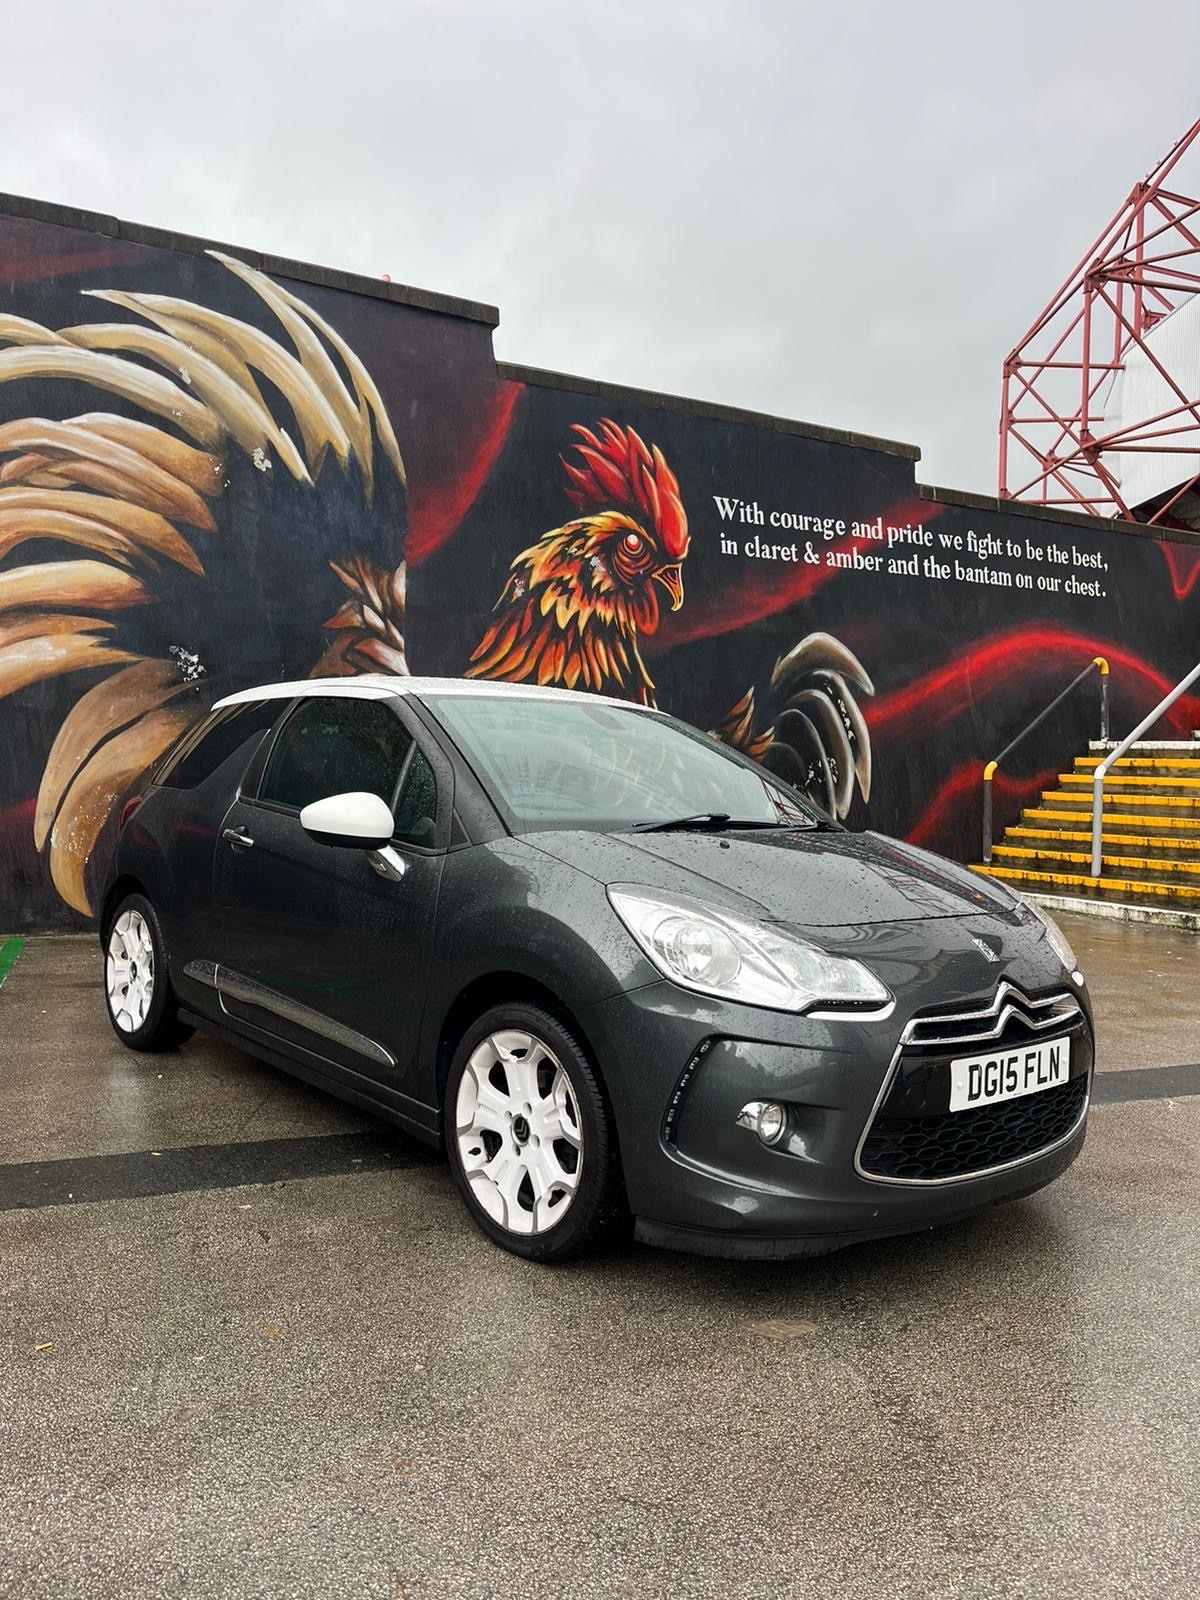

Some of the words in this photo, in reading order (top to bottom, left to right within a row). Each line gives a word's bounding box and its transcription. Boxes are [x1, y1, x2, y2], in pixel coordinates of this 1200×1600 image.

[713, 496, 765, 525] With
[770, 512, 846, 540] courage
[852, 517, 883, 540] and
[887, 524, 934, 548] pride
[938, 533, 963, 550] we
[966, 530, 1004, 560] fight
[1006, 539, 1022, 558] to
[1025, 539, 1044, 561] be
[1046, 544, 1069, 565] the
[1072, 546, 1108, 572] best,
[720, 532, 738, 555] in
[744, 535, 799, 562] claret
[804, 541, 821, 565] &
[826, 546, 884, 572] amber
[888, 554, 920, 576] and
[923, 555, 951, 580] the
[954, 560, 1012, 587] bantam
[1015, 573, 1033, 589] on
[1037, 576, 1062, 592] our
[1064, 575, 1106, 597] chest.
[968, 1056, 1018, 1102] DG15
[1024, 1046, 1060, 1088] FLN
